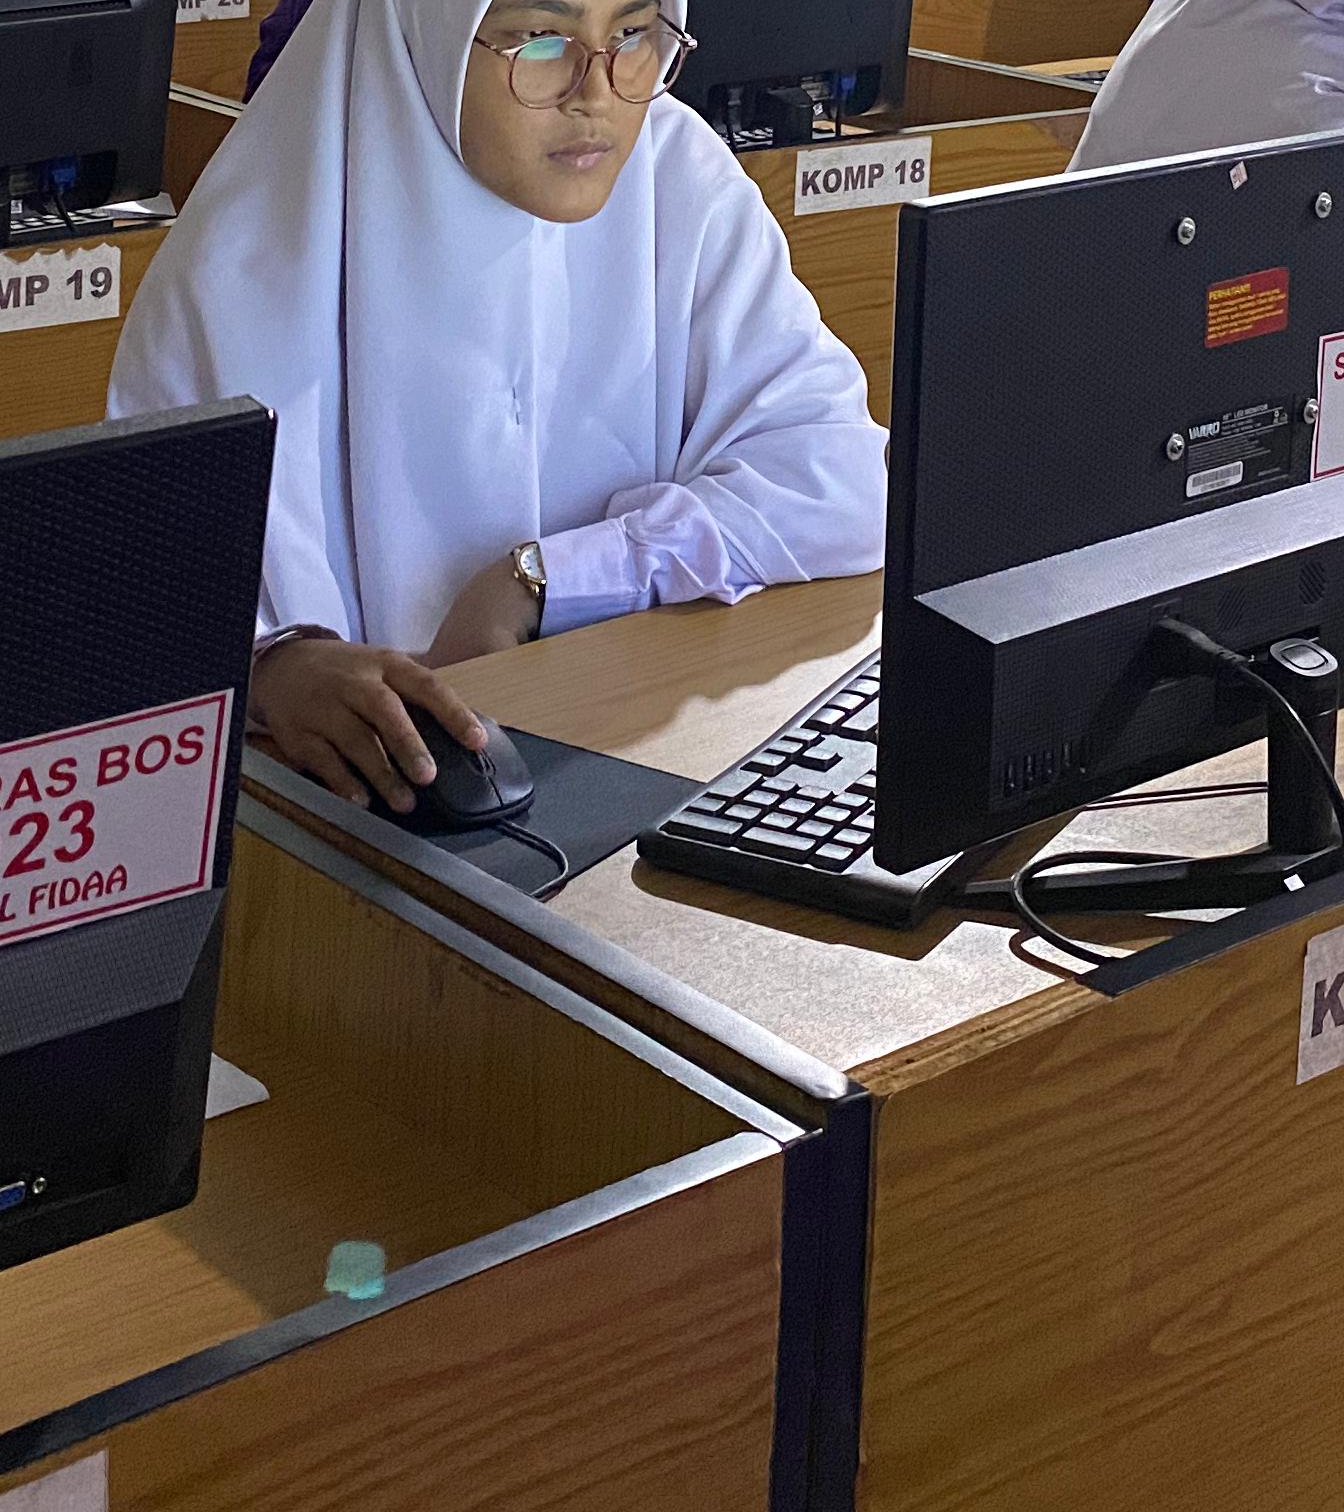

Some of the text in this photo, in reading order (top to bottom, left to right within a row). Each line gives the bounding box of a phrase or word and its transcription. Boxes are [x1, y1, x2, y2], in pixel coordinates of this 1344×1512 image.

[801, 158, 926, 197] KOMP 18
[65, 266, 113, 301] 19
[96, 725, 205, 787] BOS
[28, 864, 128, 916] FIDAA
